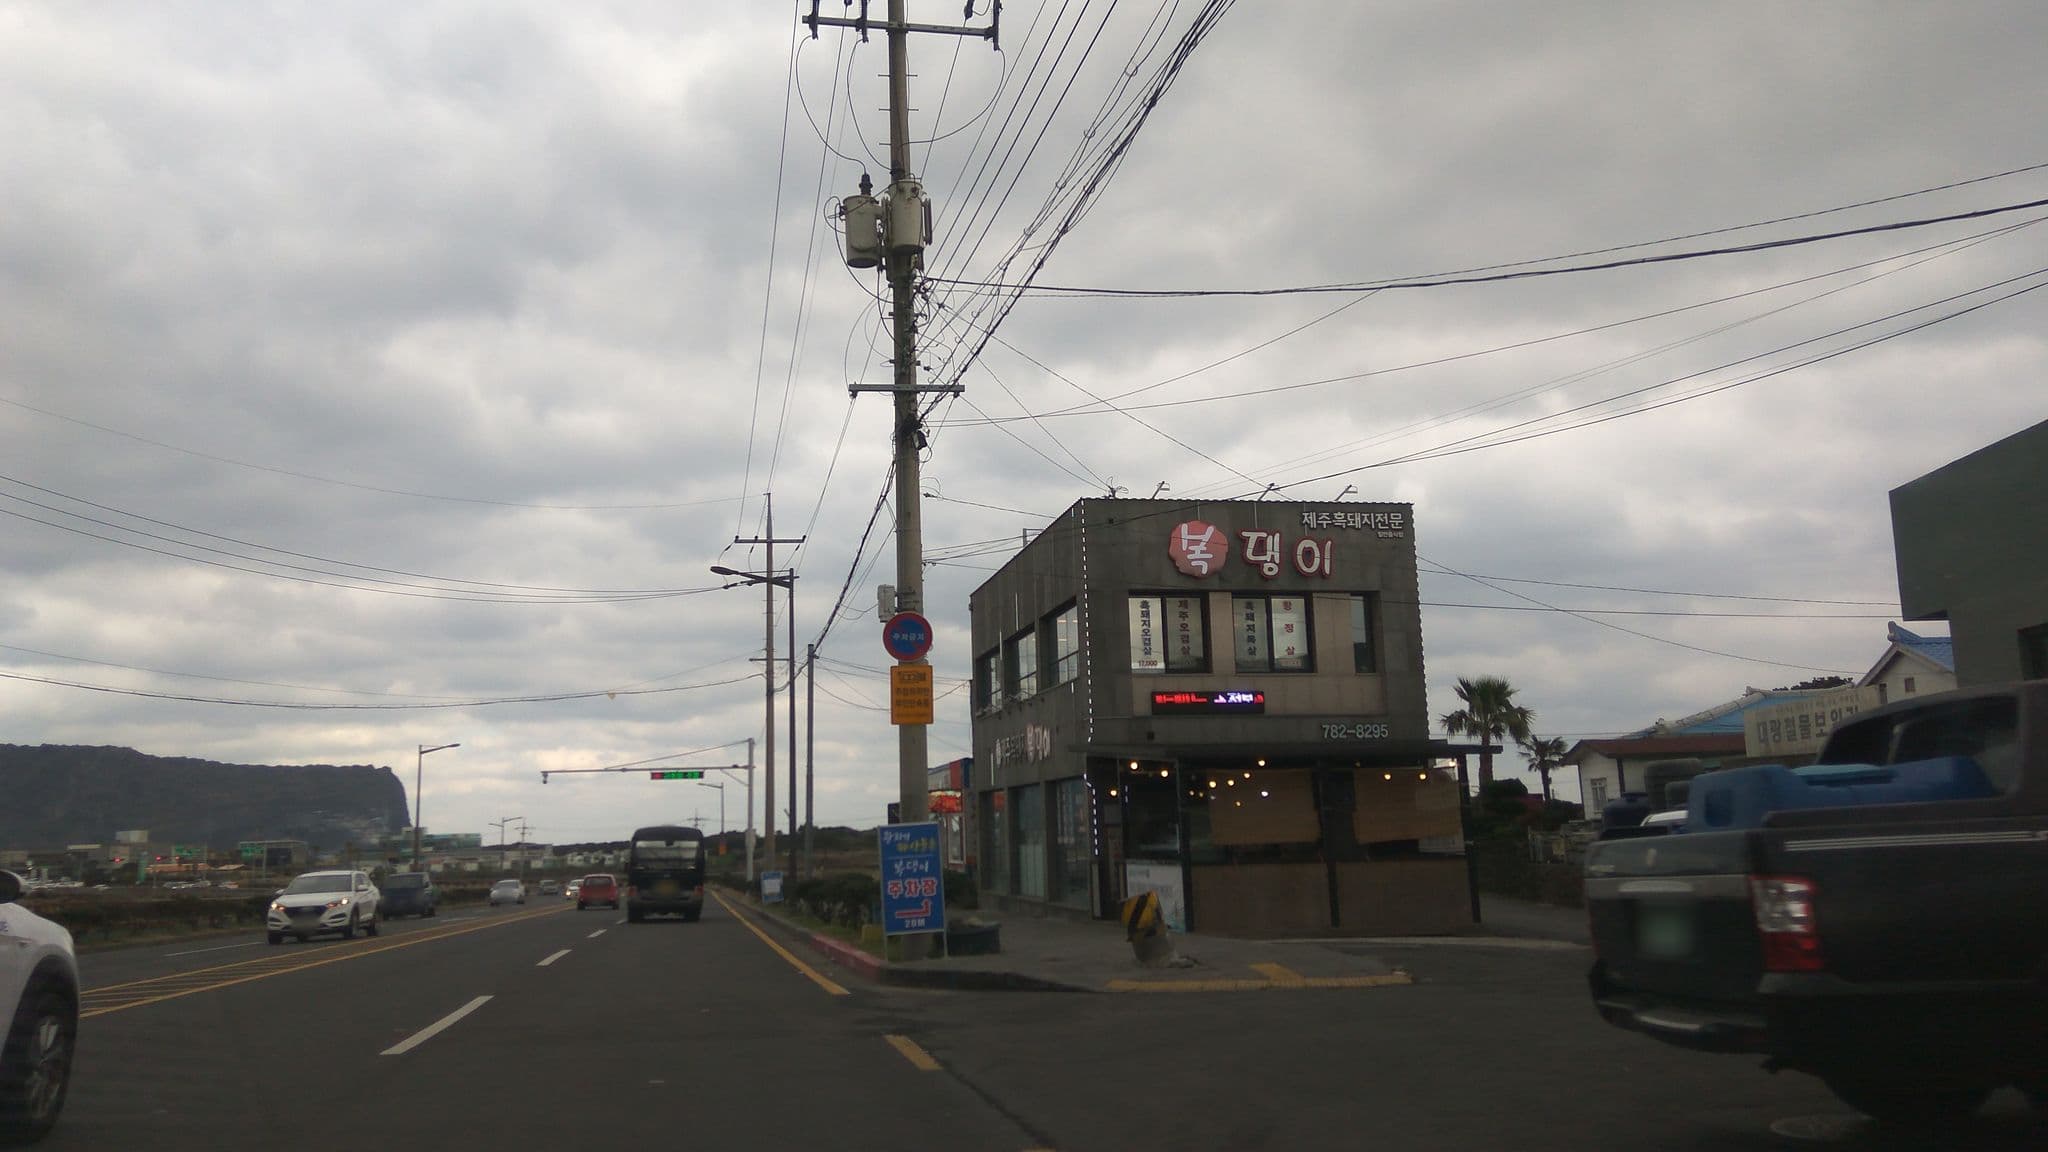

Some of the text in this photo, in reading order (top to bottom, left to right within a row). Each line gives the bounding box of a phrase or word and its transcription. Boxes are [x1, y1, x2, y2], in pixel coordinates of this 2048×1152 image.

[1302, 511, 1404, 529] 제주흑돼지전문
[1140, 600, 1152, 656] 흑돼지오겹살
[1322, 724, 1389, 739] 782-8295
[887, 879, 937, 899] 주차장
